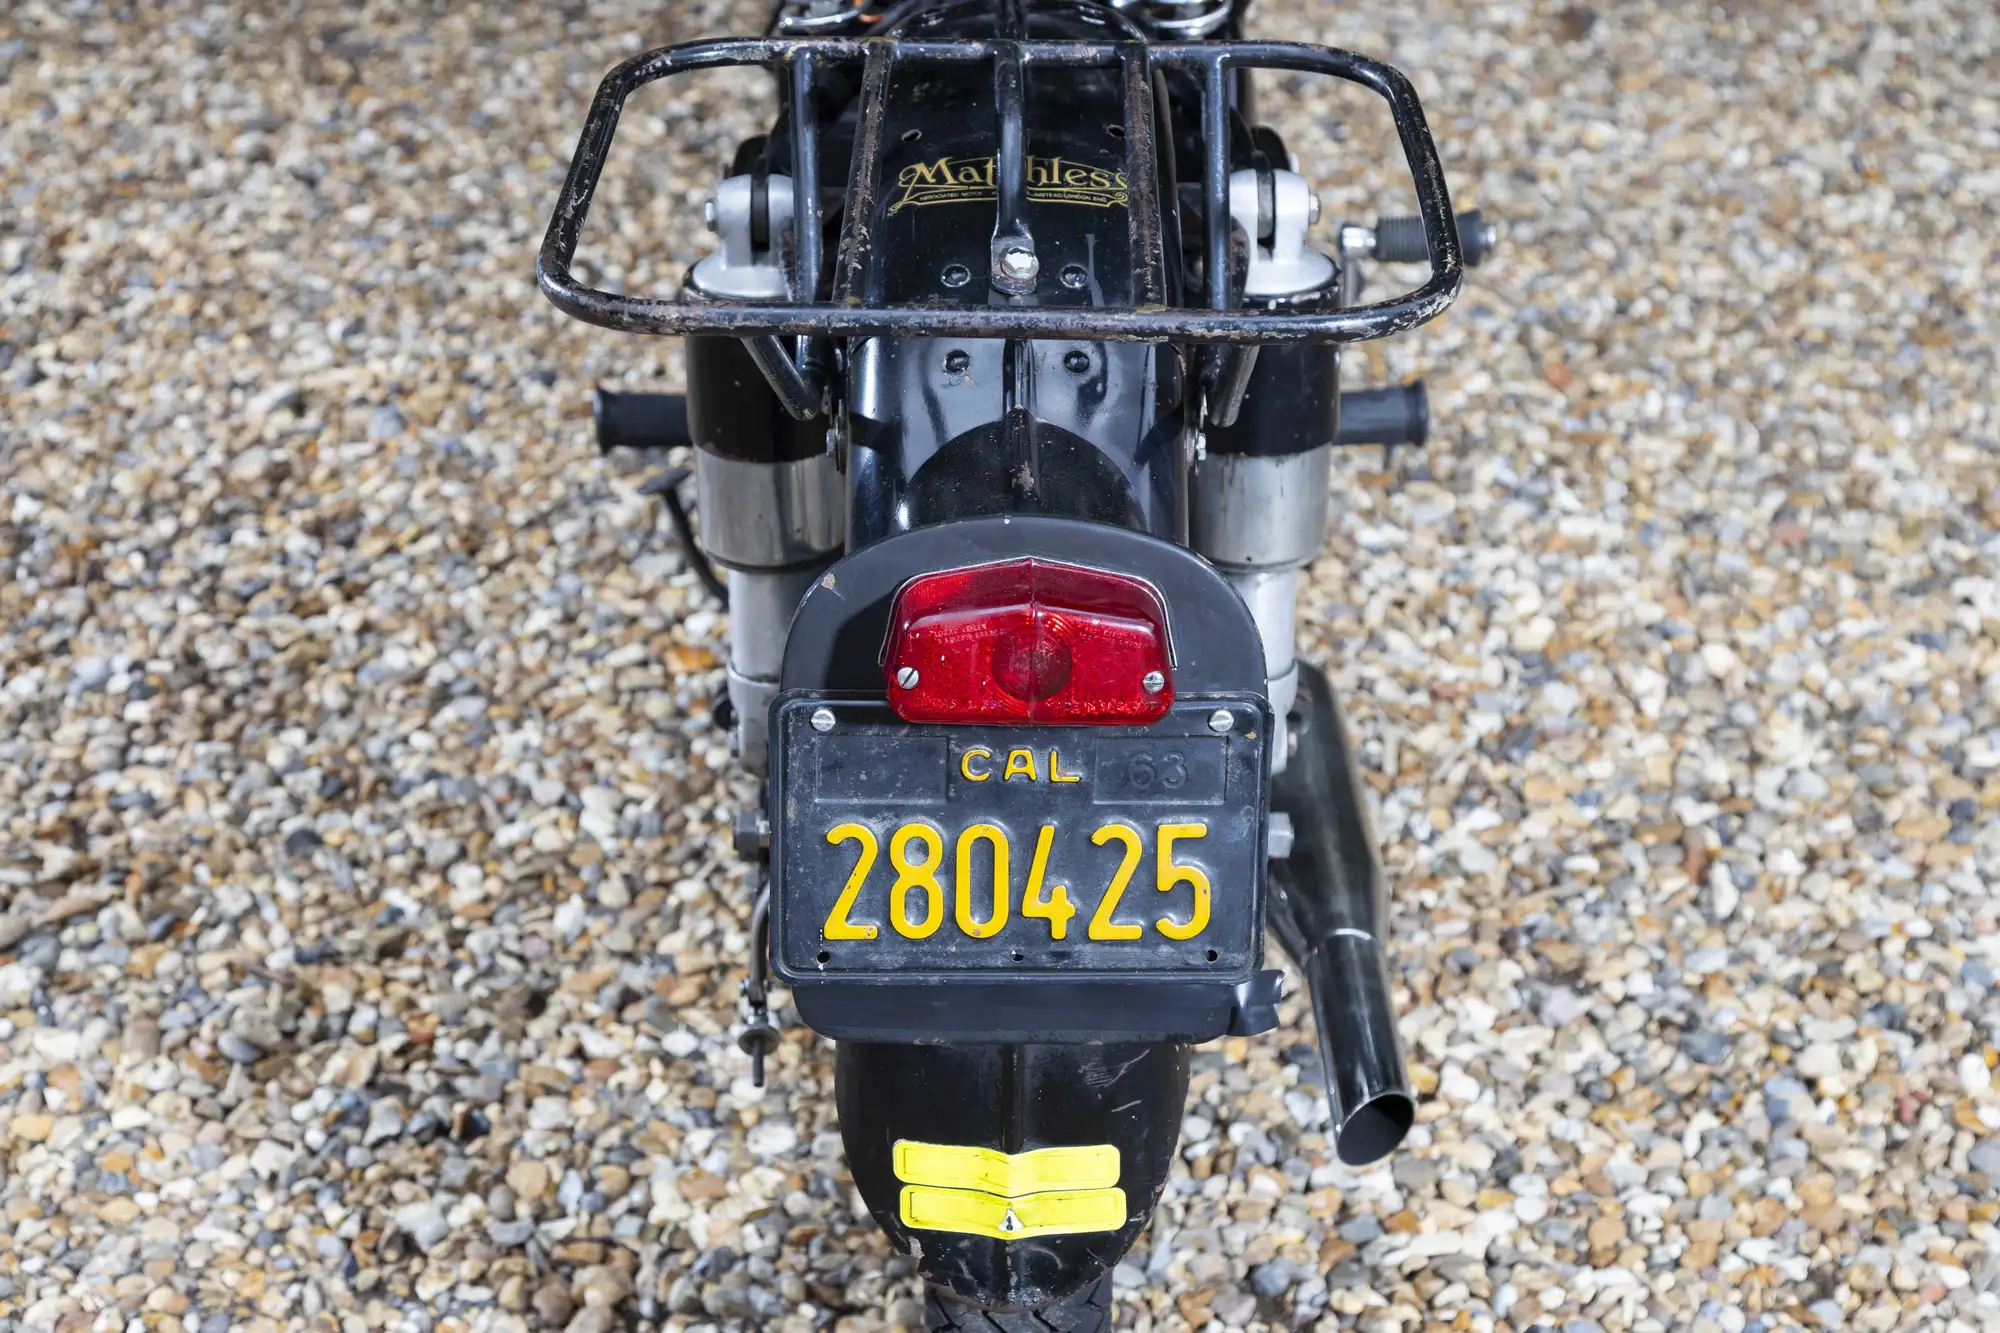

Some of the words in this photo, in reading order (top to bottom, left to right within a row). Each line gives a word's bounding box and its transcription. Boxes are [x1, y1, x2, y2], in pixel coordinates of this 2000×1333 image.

[898, 155, 1128, 201] Mathless
[961, 749, 1082, 782] CAL
[1127, 751, 1188, 789] 63
[823, 822, 1212, 941] 280425
